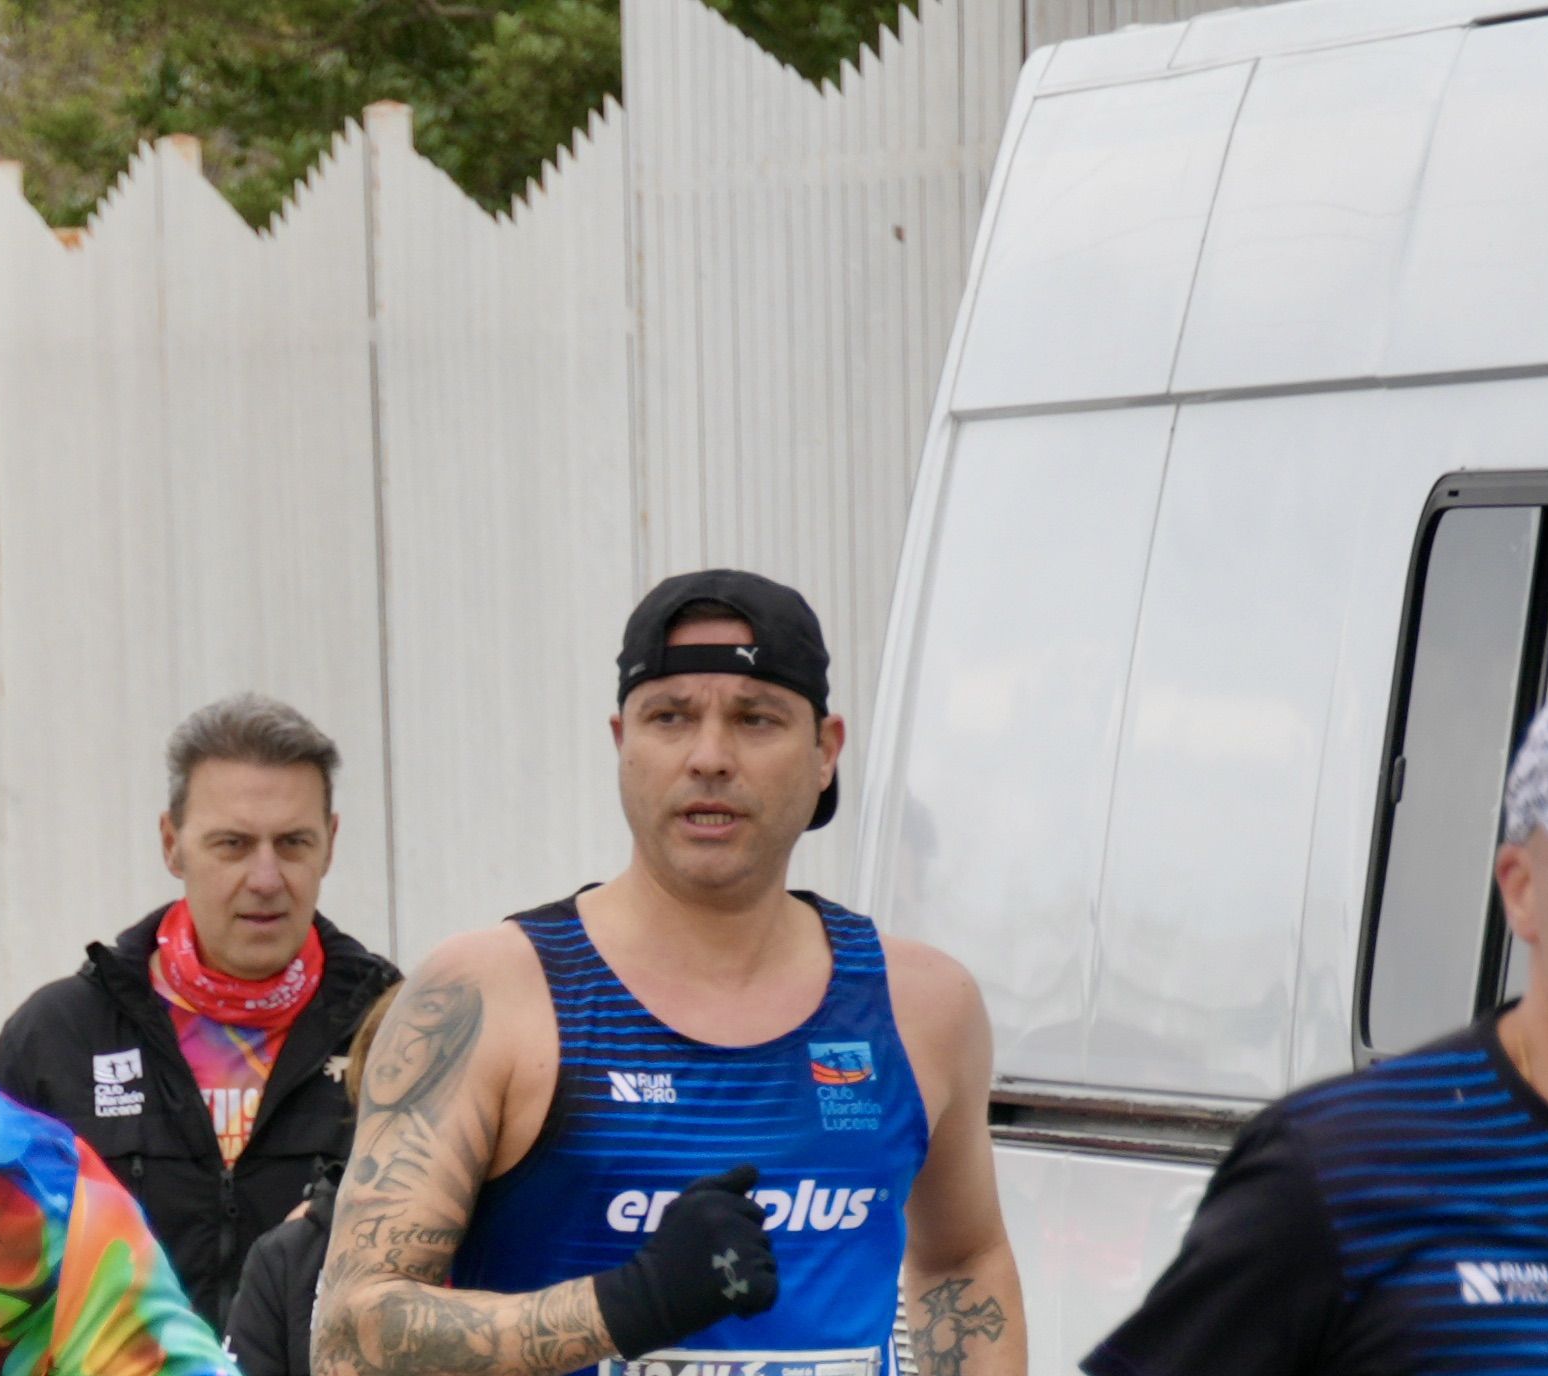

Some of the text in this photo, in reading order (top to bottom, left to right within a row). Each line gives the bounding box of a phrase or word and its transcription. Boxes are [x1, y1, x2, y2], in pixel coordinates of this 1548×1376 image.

[636, 1073, 673, 1088] RUN
[642, 1088, 677, 1104] PRO
[816, 1086, 855, 1100] Club
[822, 1115, 879, 1131] Lucena
[606, 1179, 876, 1232] enplus
